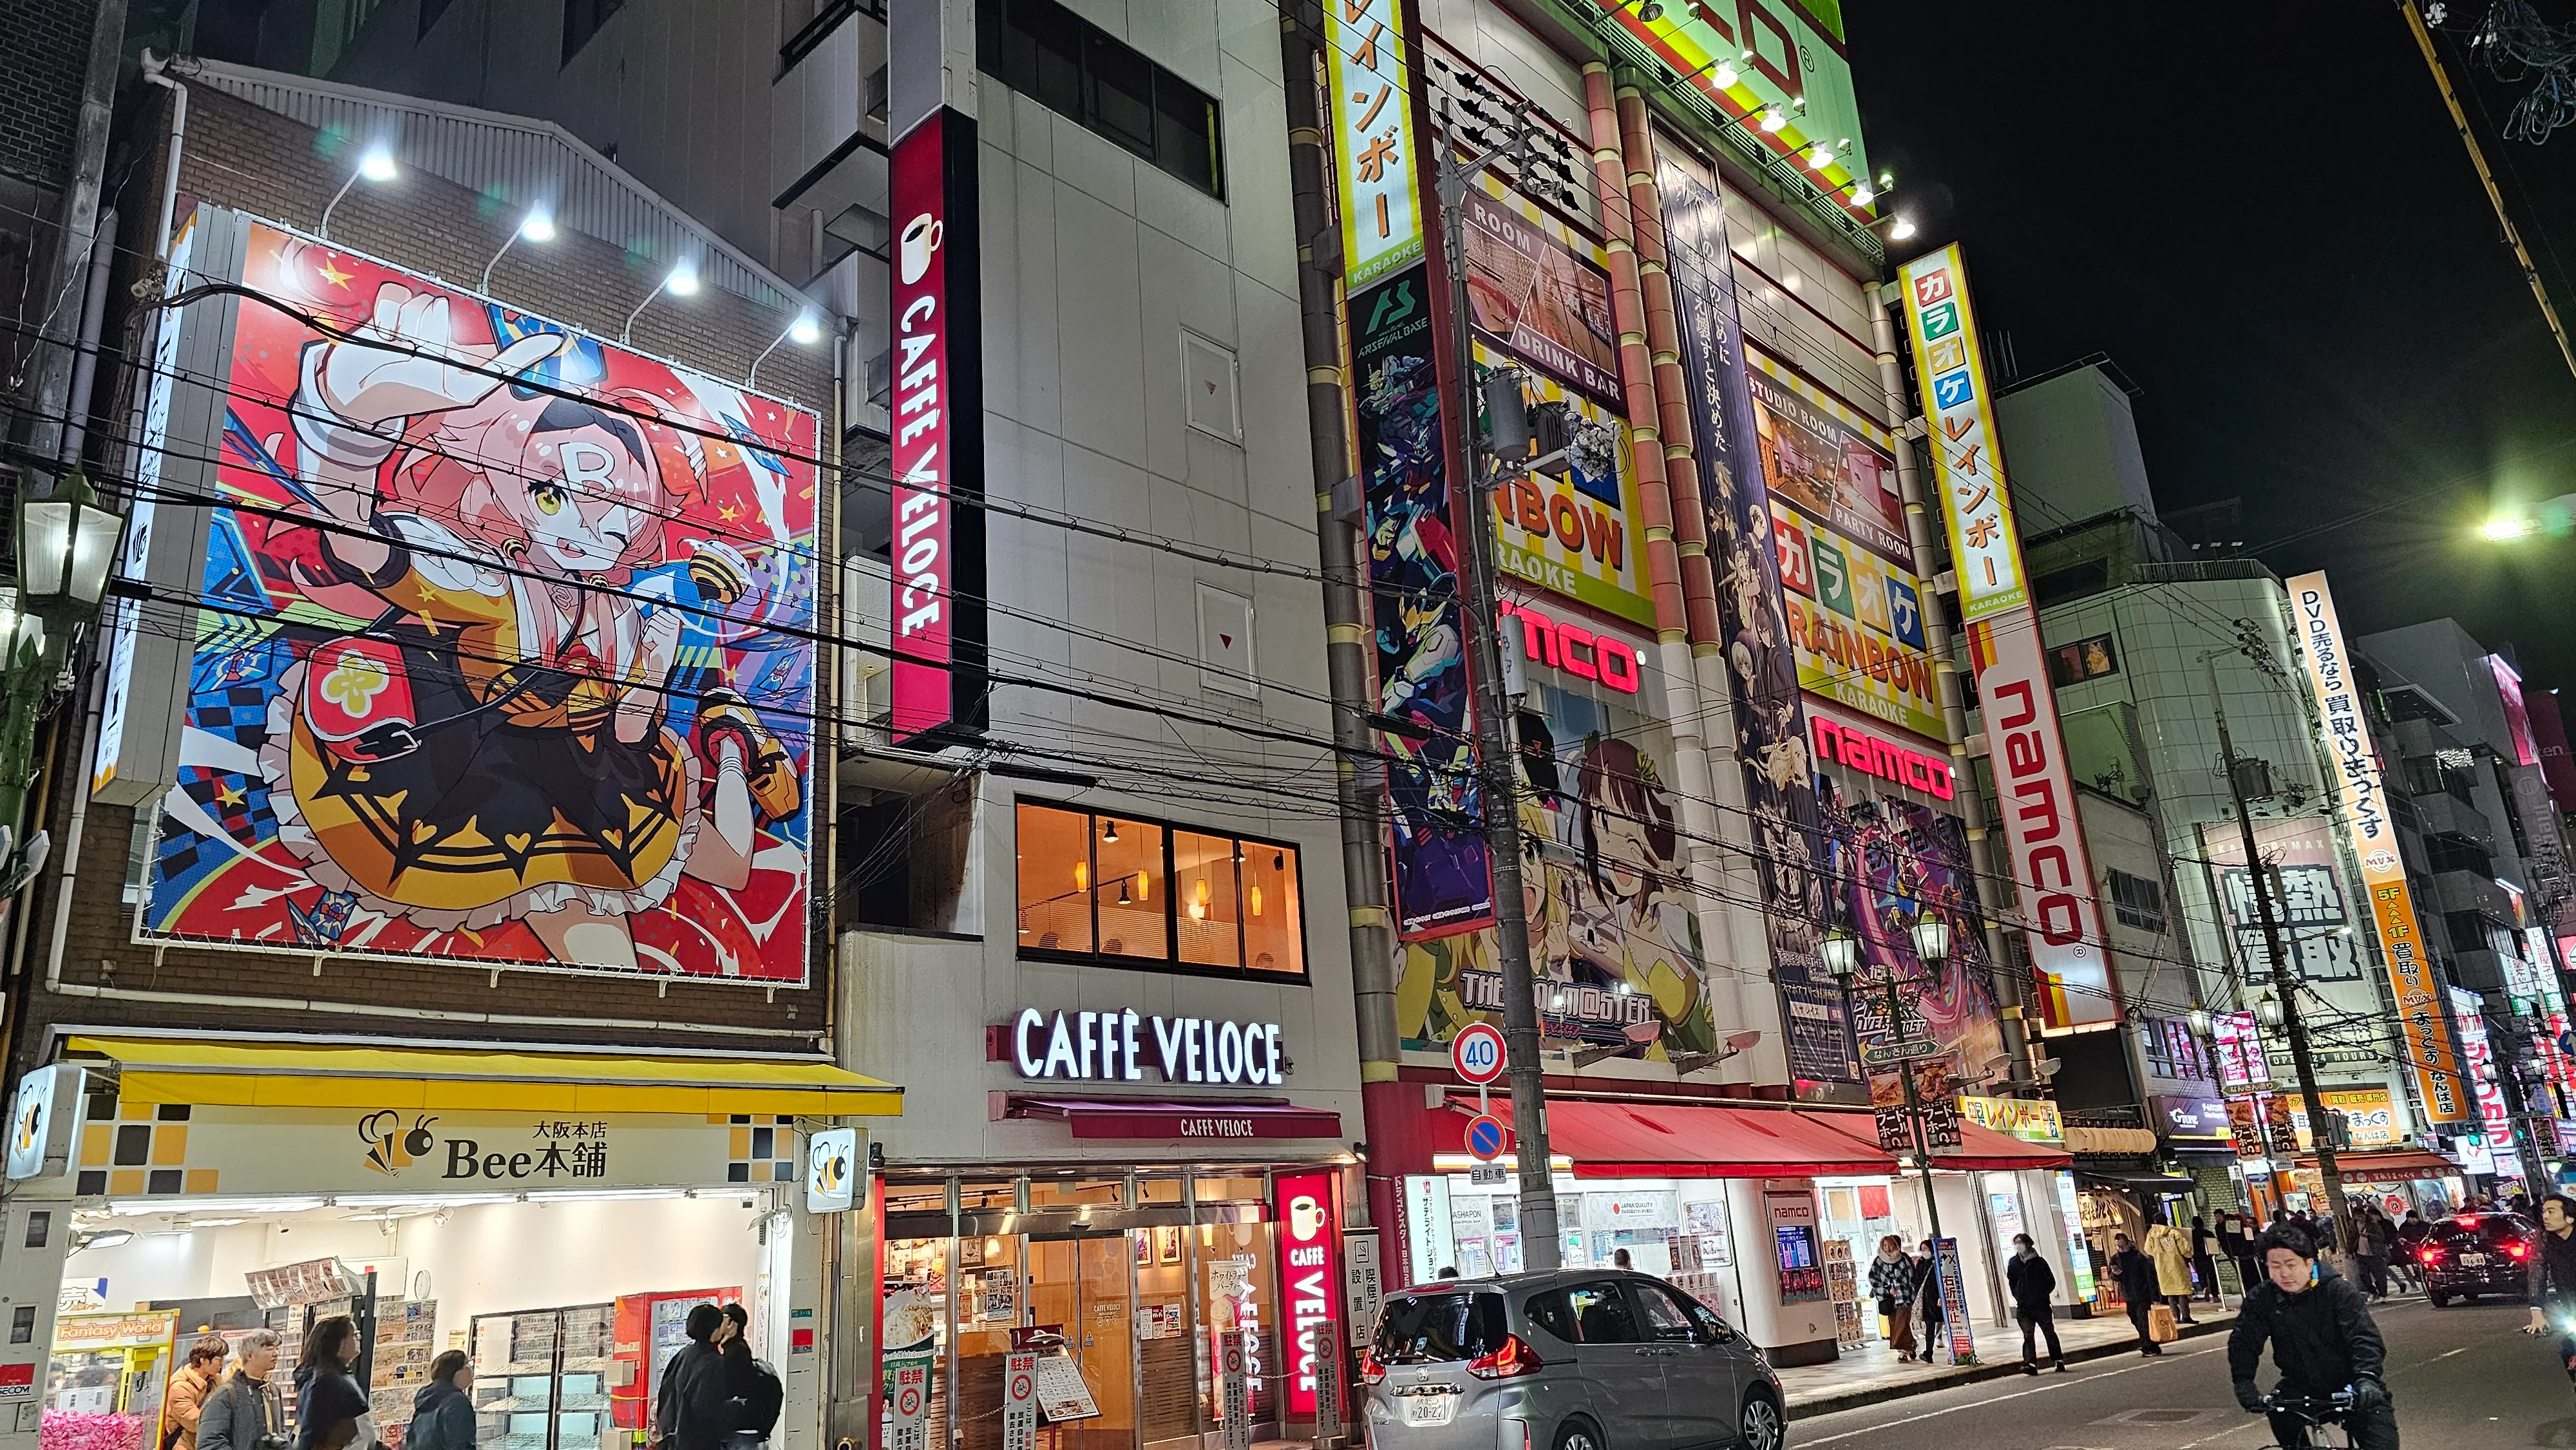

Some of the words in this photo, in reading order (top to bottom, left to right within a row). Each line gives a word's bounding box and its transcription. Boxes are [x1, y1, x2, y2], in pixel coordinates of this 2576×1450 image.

[1475, 201, 1531, 253] ROOM
[1353, 240, 1422, 283] KARAOKE
[1357, 332, 1403, 359] ARSENAL
[1403, 317, 1428, 337] BASE
[1919, 270, 1969, 404] カラオケ
[1518, 330, 1577, 384] DRINK
[1585, 368, 1622, 402] BAR
[1748, 375, 1796, 417] STUDIO
[1800, 402, 1837, 442] ROOM
[1944, 415, 2000, 586] レインボー
[902, 450, 940, 638] VELOCE
[1835, 507, 1874, 545] PARTY
[1877, 531, 1912, 562] ROOM
[1776, 536, 1918, 637] カラオケ
[1969, 589, 2025, 612] KARAOKE
[1786, 599, 1933, 703] RAINBOW
[1834, 684, 1908, 728] KARAOKE
[2301, 588, 2344, 692] DVD売るなら
[2324, 693, 2384, 838] 買取りまっくす
[1810, 715, 1954, 801] namco
[1994, 679, 2085, 946] namco
[2377, 887, 2401, 901] 5F
[2388, 926, 2409, 938] 1F
[2391, 941, 2421, 987] 買取り
[1014, 1006, 1142, 1080] CAFFÈ
[1152, 1015, 1283, 1086] VELOCE
[1465, 1040, 1494, 1067] 40
[1873, 1044, 1927, 1059] なんさん通り
[2273, 1055, 2297, 1065] OPE
[2334, 1051, 2375, 1061] HOURS
[2410, 1010, 2440, 1065] まっくす
[2430, 1069, 2456, 1115] なんば店
[2230, 1082, 2273, 1092] なんさん通り
[1921, 1100, 1953, 1109] コミュニティー
[2330, 1095, 2347, 1105] 買取
[2349, 1093, 2365, 1104] 販売
[2366, 1093, 2388, 1103] 専門店
[1874, 1106, 1904, 1115] コミュニティー
[1876, 1109, 1905, 1125] フード
[1923, 1104, 1953, 1121] フード
[1985, 1103, 2040, 1128] レインボー
[2351, 1111, 2389, 1127] まっくす
[533, 1120, 607, 1138] 大阪本店
[1180, 1117, 1214, 1136] CAFFÈ
[1215, 1118, 1254, 1137] VELOCE
[1879, 1122, 1909, 1138] ホール
[1926, 1117, 1958, 1133] ホール
[2234, 1127, 2258, 1138] フード
[2271, 1124, 2293, 1134] フード
[2238, 1136, 2262, 1147] ホール
[2273, 1131, 2297, 1142] ホール
[441, 1140, 608, 1179] Bee本舗
[1472, 1168, 1506, 1181] 自動車
[1774, 1207, 1809, 1218] namco
[1291, 1245, 1325, 1267] CAFFÈ
[1350, 1268, 1365, 1340] 設置店
[1365, 1267, 1378, 1328] 喫煙ブー
[1943, 1274, 1961, 1324] 右折禁止
[57, 1324, 120, 1341] Fantasy
[120, 1319, 166, 1337] World
[1224, 1333, 1242, 1347] 駐禁
[1316, 1323, 1334, 1335] 駐禁
[1010, 1356, 1035, 1372] 駐禁
[899, 1368, 923, 1386] 駐禁
